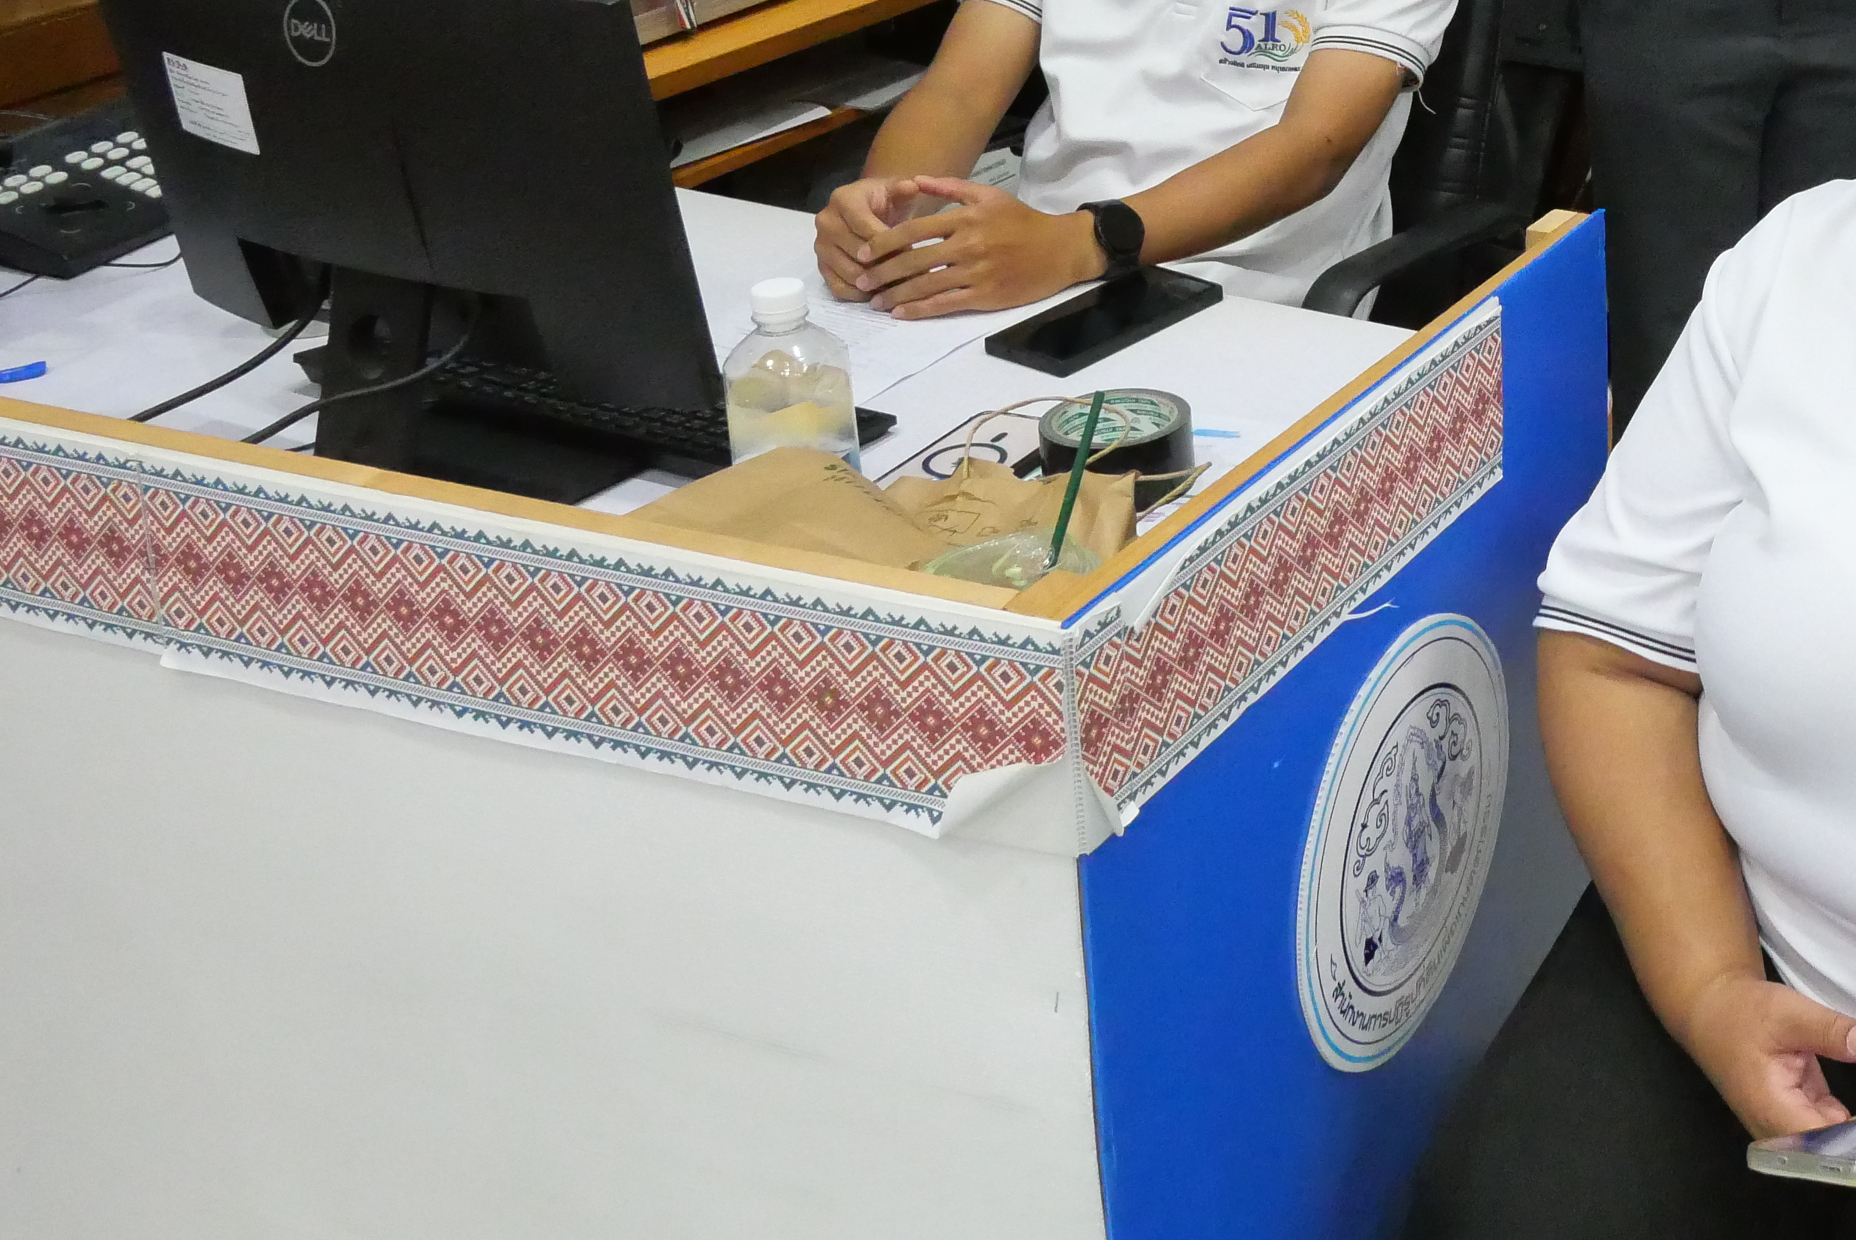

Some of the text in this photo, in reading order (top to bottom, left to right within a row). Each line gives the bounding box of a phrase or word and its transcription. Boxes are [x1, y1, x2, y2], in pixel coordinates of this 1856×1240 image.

[291, 18, 331, 42] DELL
[1220, 6, 1282, 56] 51
[1254, 43, 1287, 52] ALRO
